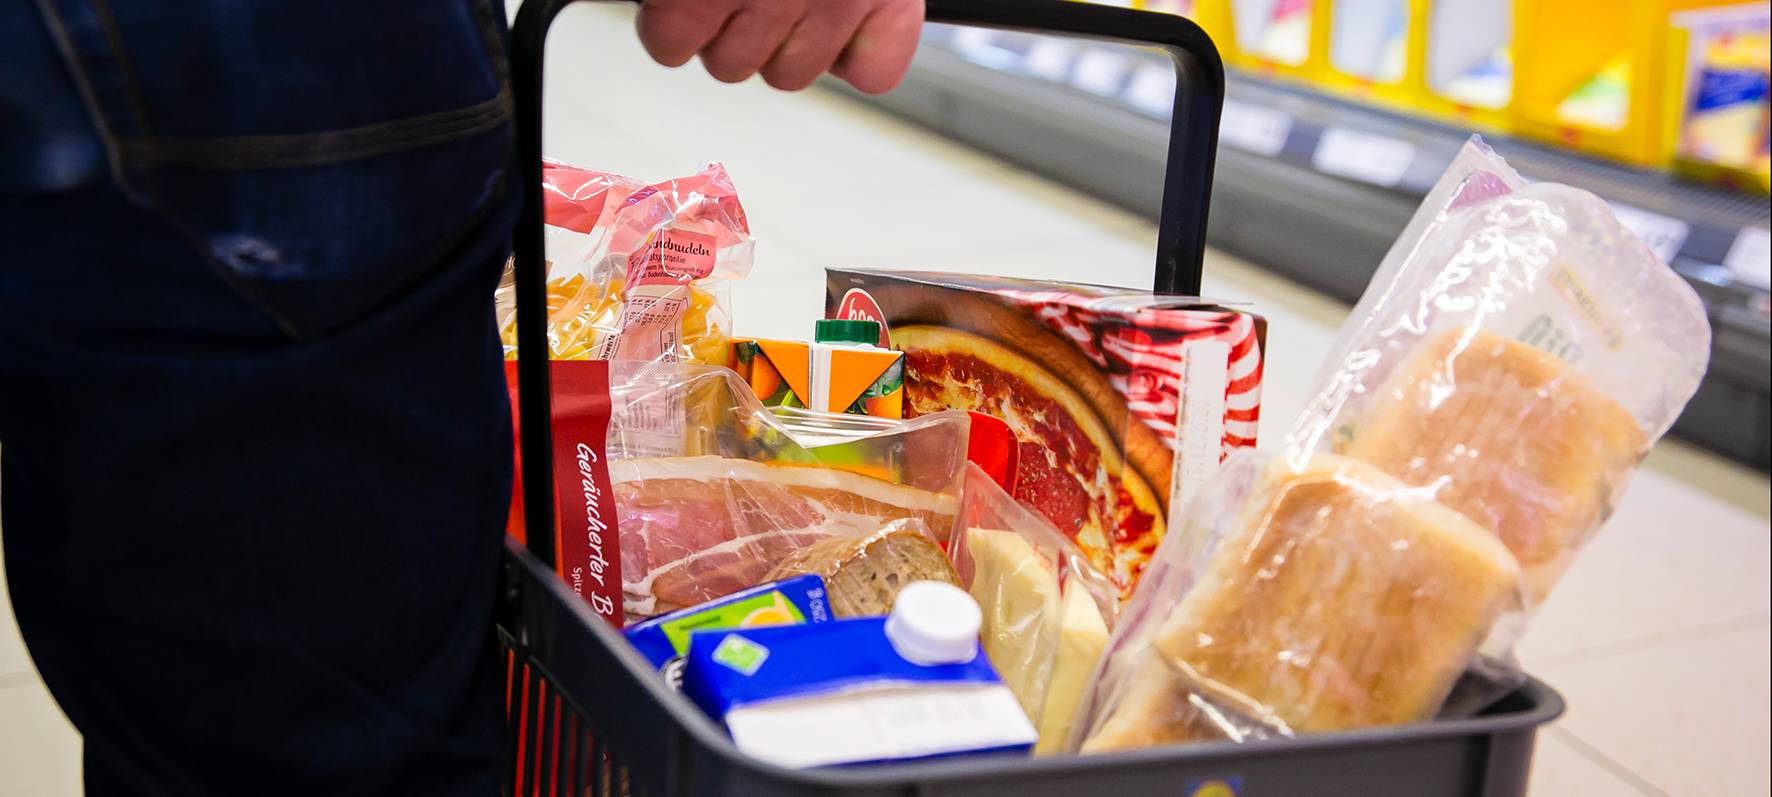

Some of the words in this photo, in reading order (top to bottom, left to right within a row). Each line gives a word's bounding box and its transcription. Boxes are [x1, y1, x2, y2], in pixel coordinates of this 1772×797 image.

[653, 237, 710, 257] ndnudeln
[575, 442, 609, 587] Geräucherter
[591, 596, 613, 619] B
